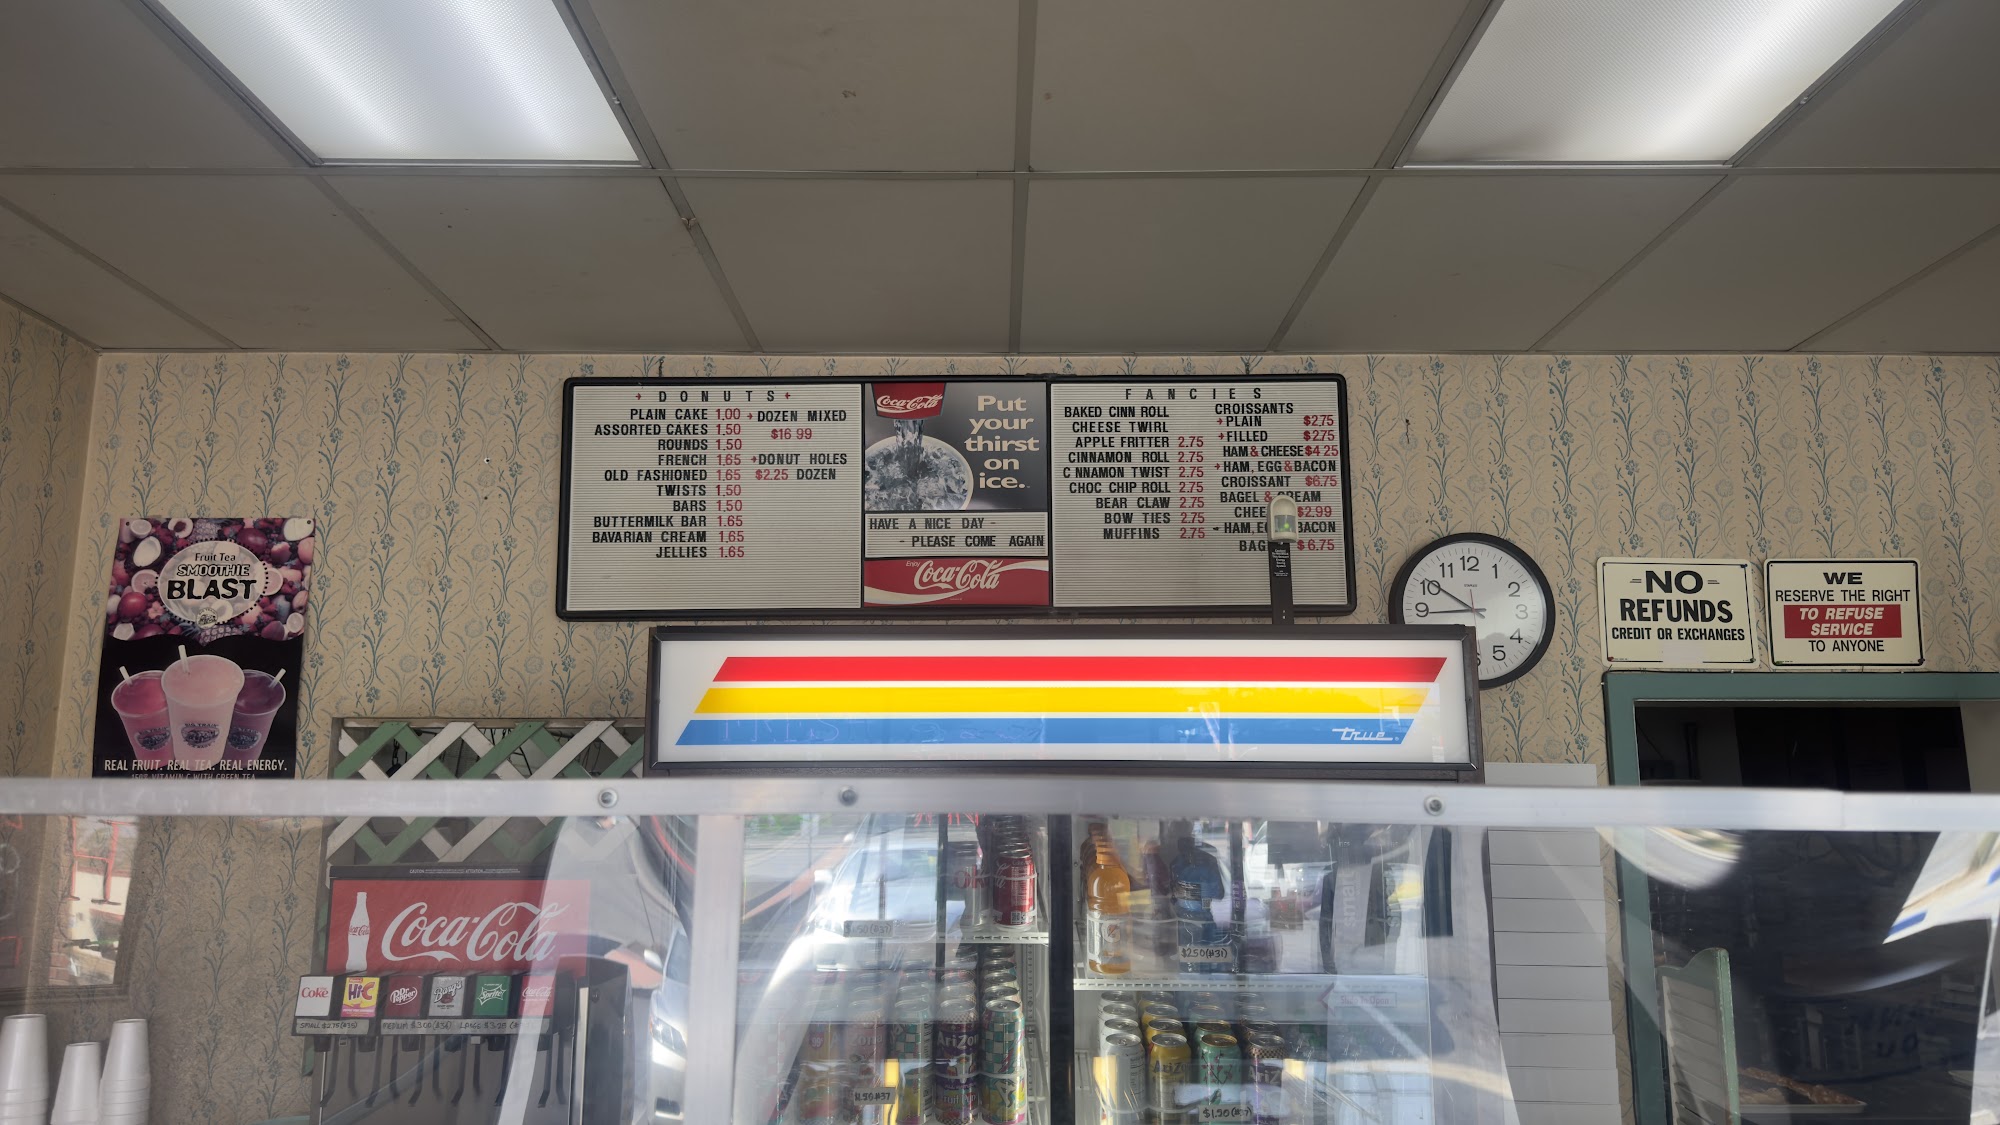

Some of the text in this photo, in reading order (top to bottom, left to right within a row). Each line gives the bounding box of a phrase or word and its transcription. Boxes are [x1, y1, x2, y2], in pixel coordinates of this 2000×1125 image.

[877, 394, 943, 411] Coca-Cola
[977, 395, 1027, 412] Put
[1215, 403, 1294, 414] CROISSANTS
[630, 408, 741, 421] PLAIN CAKE 1.00
[757, 410, 847, 422] DOZEN MIXED
[1064, 406, 1170, 417] BAKED CINN ROLL
[969, 418, 1034, 434] your
[1072, 421, 1169, 433] CHEESE TWIRL
[1226, 415, 1334, 427] PLAIN $2.75
[594, 424, 741, 437] ASSORTED CAKES 1.50
[1227, 431, 1268, 442] FILLED
[658, 439, 742, 452] ROUNDS 1.50
[964, 436, 1040, 452] thirst
[1075, 436, 1204, 448] APPLE FRITTER 2.75
[658, 454, 741, 467] FRENCH 1.65
[758, 453, 848, 465] DONUT HOLES
[1068, 451, 1204, 463] CINNAMON ROLL 2.75
[984, 458, 1020, 471] on
[1258, 460, 1282, 472] EGG
[1294, 460, 1336, 472] BACON
[604, 469, 741, 482] OLD FASHIONED 1.65
[755, 468, 836, 480] $2.25 DOZEN
[1131, 466, 1204, 478] TWIST 2.75
[979, 472, 1025, 489] ice.
[1069, 481, 1204, 493] CHOC CHIP ROLL 2.75
[1221, 475, 1338, 488] CROISSANT $6.75
[656, 484, 741, 497] TWISTS 1.50
[1220, 491, 1272, 503] BAGEL &
[673, 500, 742, 513] BARS 1.50
[1096, 497, 1204, 509] BEAR CLAW 2.75
[1104, 512, 1205, 524] BOW TIES 2.75
[1234, 505, 1332, 518] CHEE $2.99
[594, 515, 743, 528] BUTTERMILK BAR 1.65
[869, 517, 985, 530] HAVE A NICE DAY
[1297, 521, 1336, 533] BACON
[592, 530, 744, 543] BAVARIAN CREAM 1.65
[1103, 528, 1205, 539] MUFFINS 2.75
[911, 535, 1044, 548] PLEASE COME AGAIN
[195, 553, 236, 562] Fruit Tea
[656, 546, 744, 559] JELLIES 1.65
[1440, 562, 1453, 578] 11
[1460, 555, 1480, 572] 12
[177, 564, 251, 577] SMOOTHIE
[906, 559, 1003, 590] Enjoy Coca-Cola
[1492, 563, 1498, 579] 1
[1646, 570, 1704, 594] NO
[1823, 572, 1863, 585] WE
[167, 578, 257, 600] BLAST
[1420, 580, 1442, 596] 10
[1508, 581, 1521, 598] 2
[1775, 589, 1910, 602] RESERVE THE RIGHT
[1415, 602, 1429, 618] 9
[1515, 604, 1529, 620] 3
[1620, 599, 1733, 623] REFUNDS
[1800, 607, 1884, 620] TO REFUSE
[1509, 628, 1523, 644] 4
[1611, 627, 1745, 641] CREDIT OR EXCHANGES
[1810, 623, 1873, 636] SERVICE
[1808, 640, 1885, 652] TO ANYONE
[1492, 645, 1506, 661] 5
[104, 759, 288, 771] REAL FRUIT. REAL TEA. REAL ENERGY.
[381, 901, 570, 962] Coca-Cola
[301, 986, 329, 998] Coke
